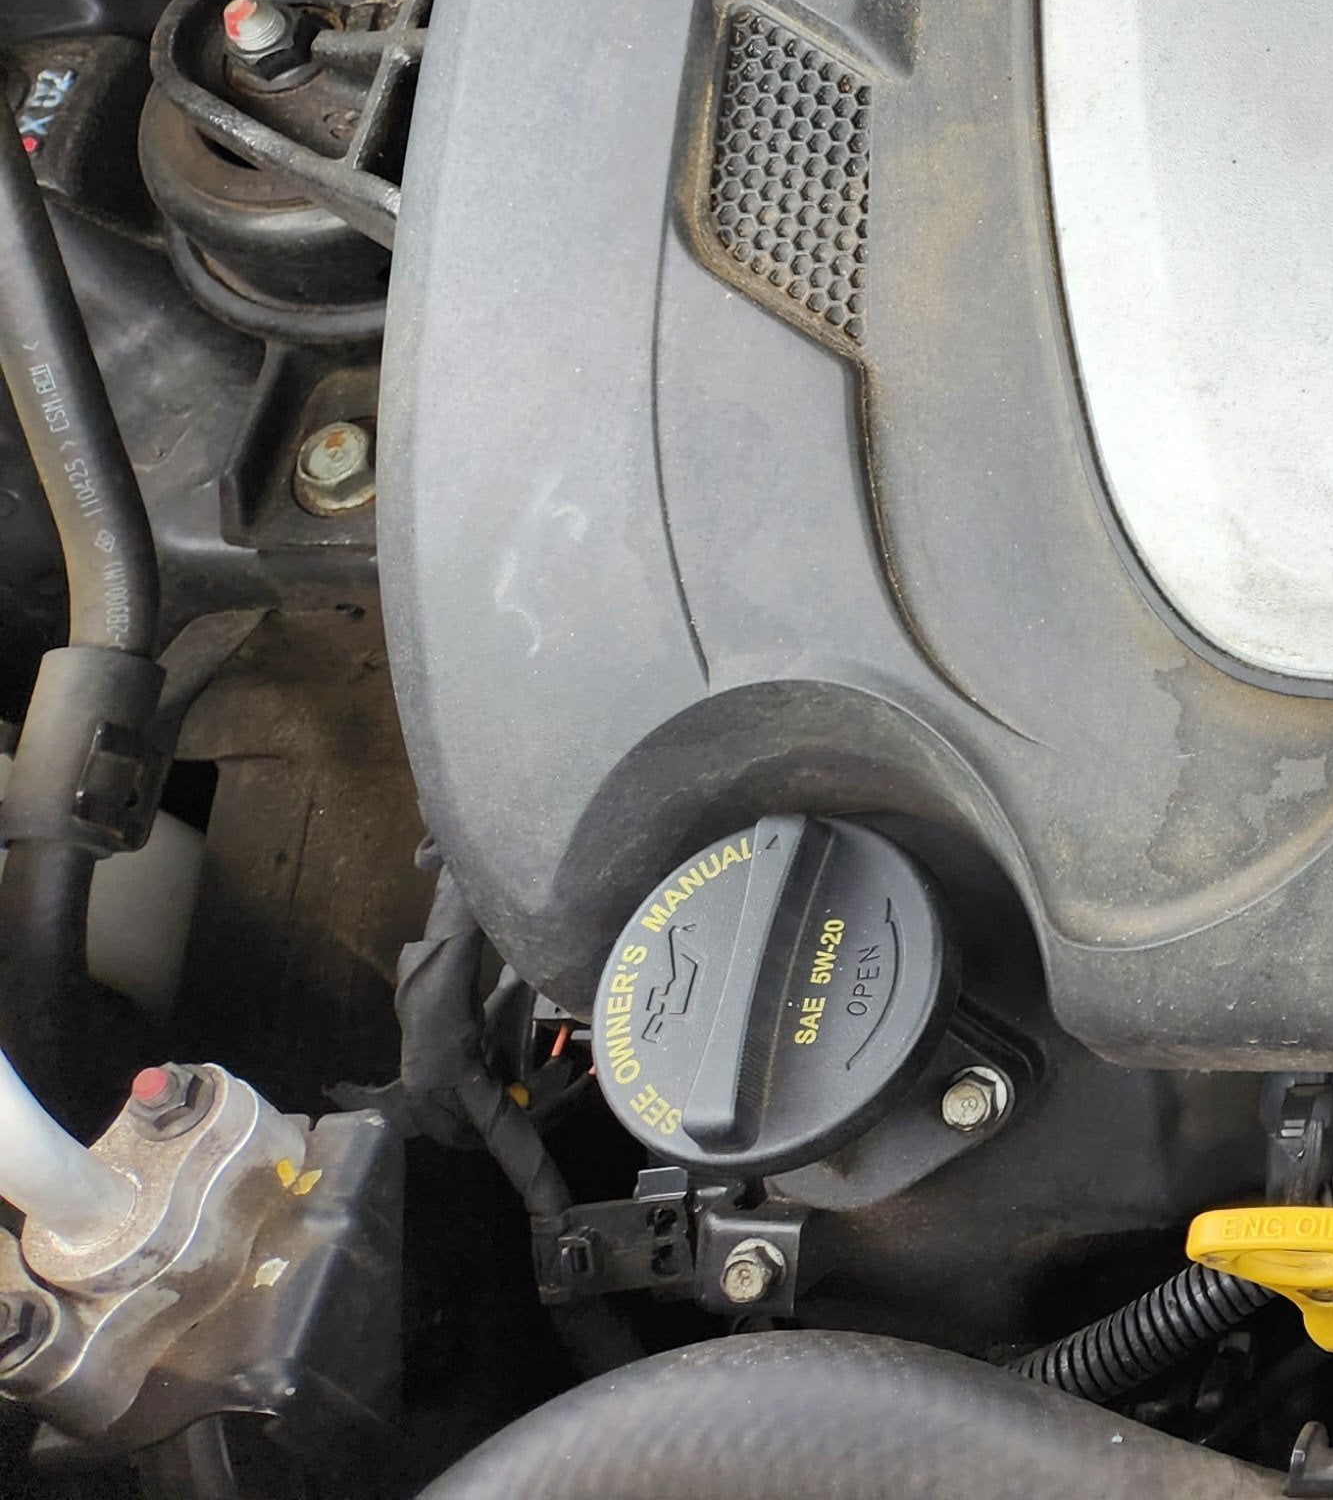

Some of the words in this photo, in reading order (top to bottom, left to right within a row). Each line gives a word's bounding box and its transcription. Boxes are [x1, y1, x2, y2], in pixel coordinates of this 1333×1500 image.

[63, 457, 102, 518] 110425
[641, 837, 754, 934] MANUAL
[605, 944, 648, 1084] OWNER'S
[794, 996, 826, 1046] SAE
[810, 918, 845, 985] 5W-20
[846, 944, 881, 1017] OPEN
[629, 1084, 683, 1136] SEE
[1219, 1215, 1286, 1241] ENG
